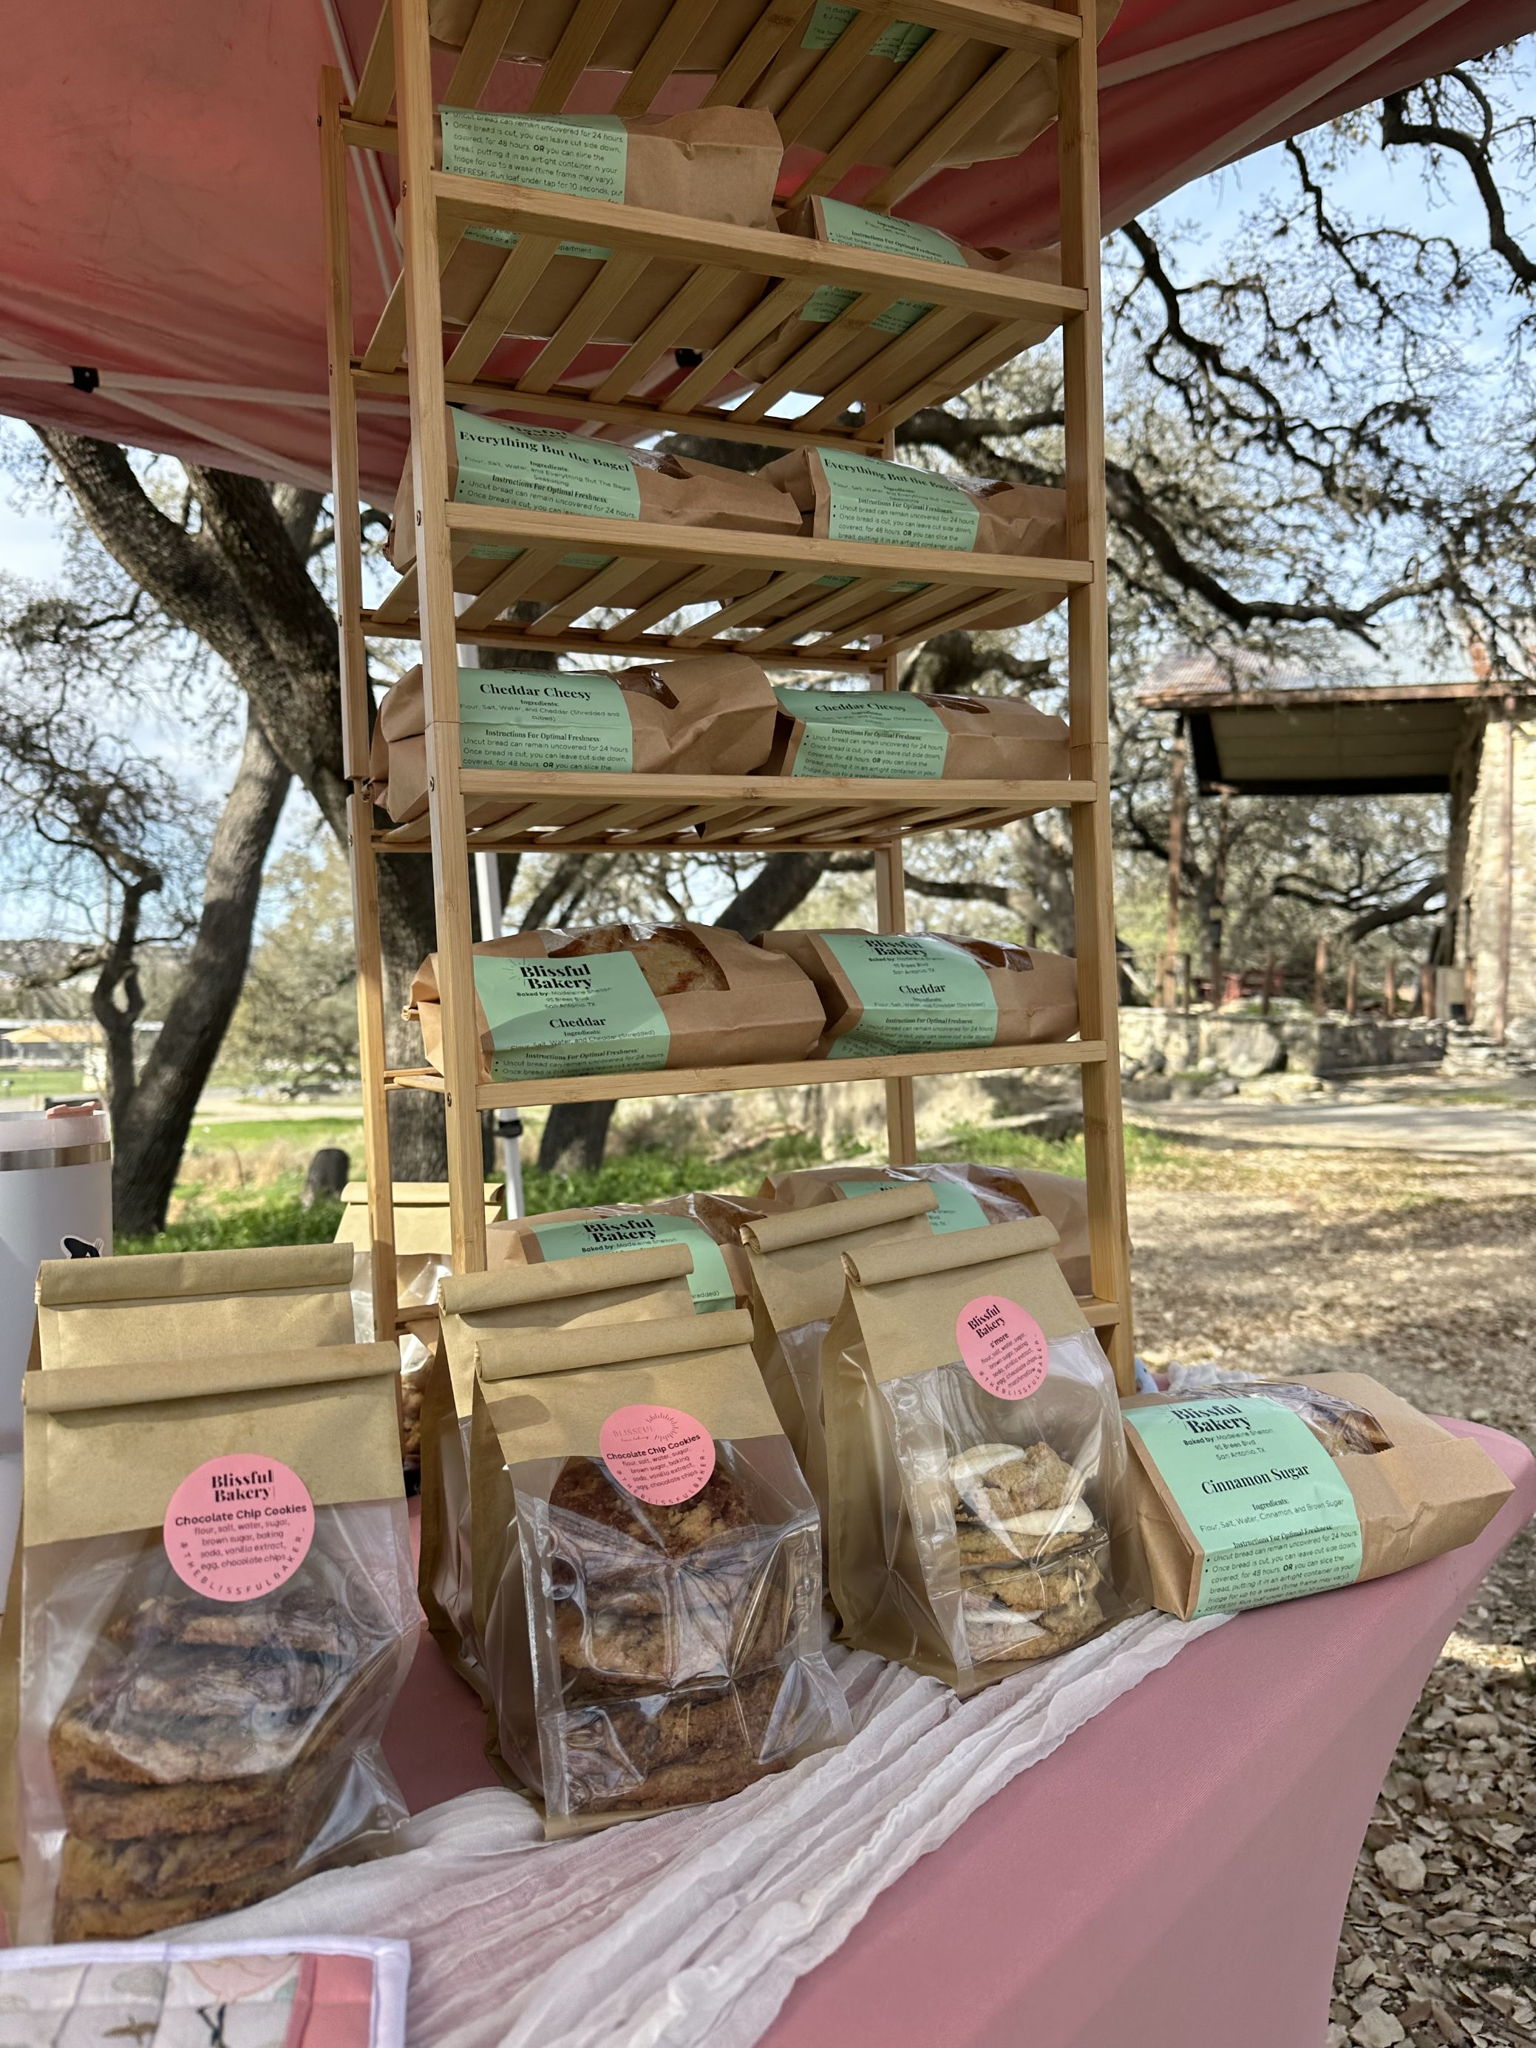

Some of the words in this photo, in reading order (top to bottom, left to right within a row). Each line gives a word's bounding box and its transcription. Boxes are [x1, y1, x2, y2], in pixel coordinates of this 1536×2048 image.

[533, 144, 545, 152] OR
[460, 431, 538, 453] Everything
[542, 444, 565, 457] But
[568, 452, 589, 463] the
[593, 458, 630, 471] Bagel
[824, 458, 886, 479] Everything
[887, 473, 907, 483] But
[910, 476, 927, 485] the
[492, 475, 533, 489] Instructions
[547, 486, 574, 497] Optimal
[468, 480, 491, 491] Uncut
[492, 485, 514, 495] bread
[515, 489, 528, 497] can
[555, 497, 593, 510] uncovered
[593, 504, 604, 513] for
[605, 506, 614, 514] 24
[480, 683, 540, 697] Cheddar
[544, 687, 591, 701] Cheesy
[815, 703, 865, 712] Cheddar
[867, 703, 906, 712] Cheesy
[485, 729, 526, 739] Instructions
[527, 731, 539, 739] For
[540, 733, 567, 743] Optimal
[832, 728, 864, 737] Instructions
[488, 739, 509, 747] bread
[550, 743, 587, 751] uncovered
[559, 753, 578, 761] leave
[592, 754, 606, 762] side
[864, 939, 924, 950] Blissful
[874, 947, 927, 957] Bakery
[520, 963, 591, 978] Blissful
[527, 977, 592, 990] Bakery
[899, 983, 946, 995] Cheddar
[549, 1017, 607, 1029] Cheddar
[525, 1052, 566, 1060] Instructions
[567, 1052, 579, 1060] For
[580, 1050, 606, 1059] Optimal
[585, 1218, 655, 1233] Blissful
[592, 1228, 656, 1244] Bakery
[582, 1244, 603, 1253] Baked
[968, 1305, 1000, 1330] Blissful
[976, 1317, 1005, 1339] Bakery
[1171, 1404, 1243, 1421] Blissful
[1186, 1416, 1251, 1434] Bakery
[606, 1450, 647, 1460] Chocolate
[648, 1446, 667, 1455] Chip
[668, 1434, 701, 1449] Cookies
[1183, 1436, 1204, 1446] Baked
[212, 1470, 273, 1488] Blissful
[1201, 1471, 1272, 1495] Cinnamon
[1271, 1464, 1310, 1482] Sugar
[215, 1487, 270, 1502] Bakery
[175, 1513, 234, 1526] Chocolate
[236, 1509, 262, 1520] Chip
[265, 1504, 307, 1516] Cookies
[1294, 1505, 1306, 1514] and
[1307, 1502, 1326, 1512] Brown
[194, 1525, 216, 1535] flour,
[238, 1522, 263, 1531] water,
[265, 1519, 290, 1528] sugar,
[202, 1536, 228, 1546] brown
[256, 1530, 283, 1542] baking
[1233, 1535, 1269, 1549] Instructions
[225, 1545, 252, 1556] vanilla
[1214, 1551, 1235, 1563] Uncut
[1235, 1547, 1254, 1559] bread
[1254, 1546, 1267, 1554] can
[1289, 1536, 1321, 1550] uncovered
[1322, 1534, 1331, 1543] for
[1331, 1532, 1340, 1541] 24
[221, 1556, 263, 1568] chocolate
[1212, 1561, 1230, 1573] Once
[1231, 1559, 1251, 1570] bread
[1271, 1554, 1284, 1565] you
[1284, 1552, 1298, 1560] can
